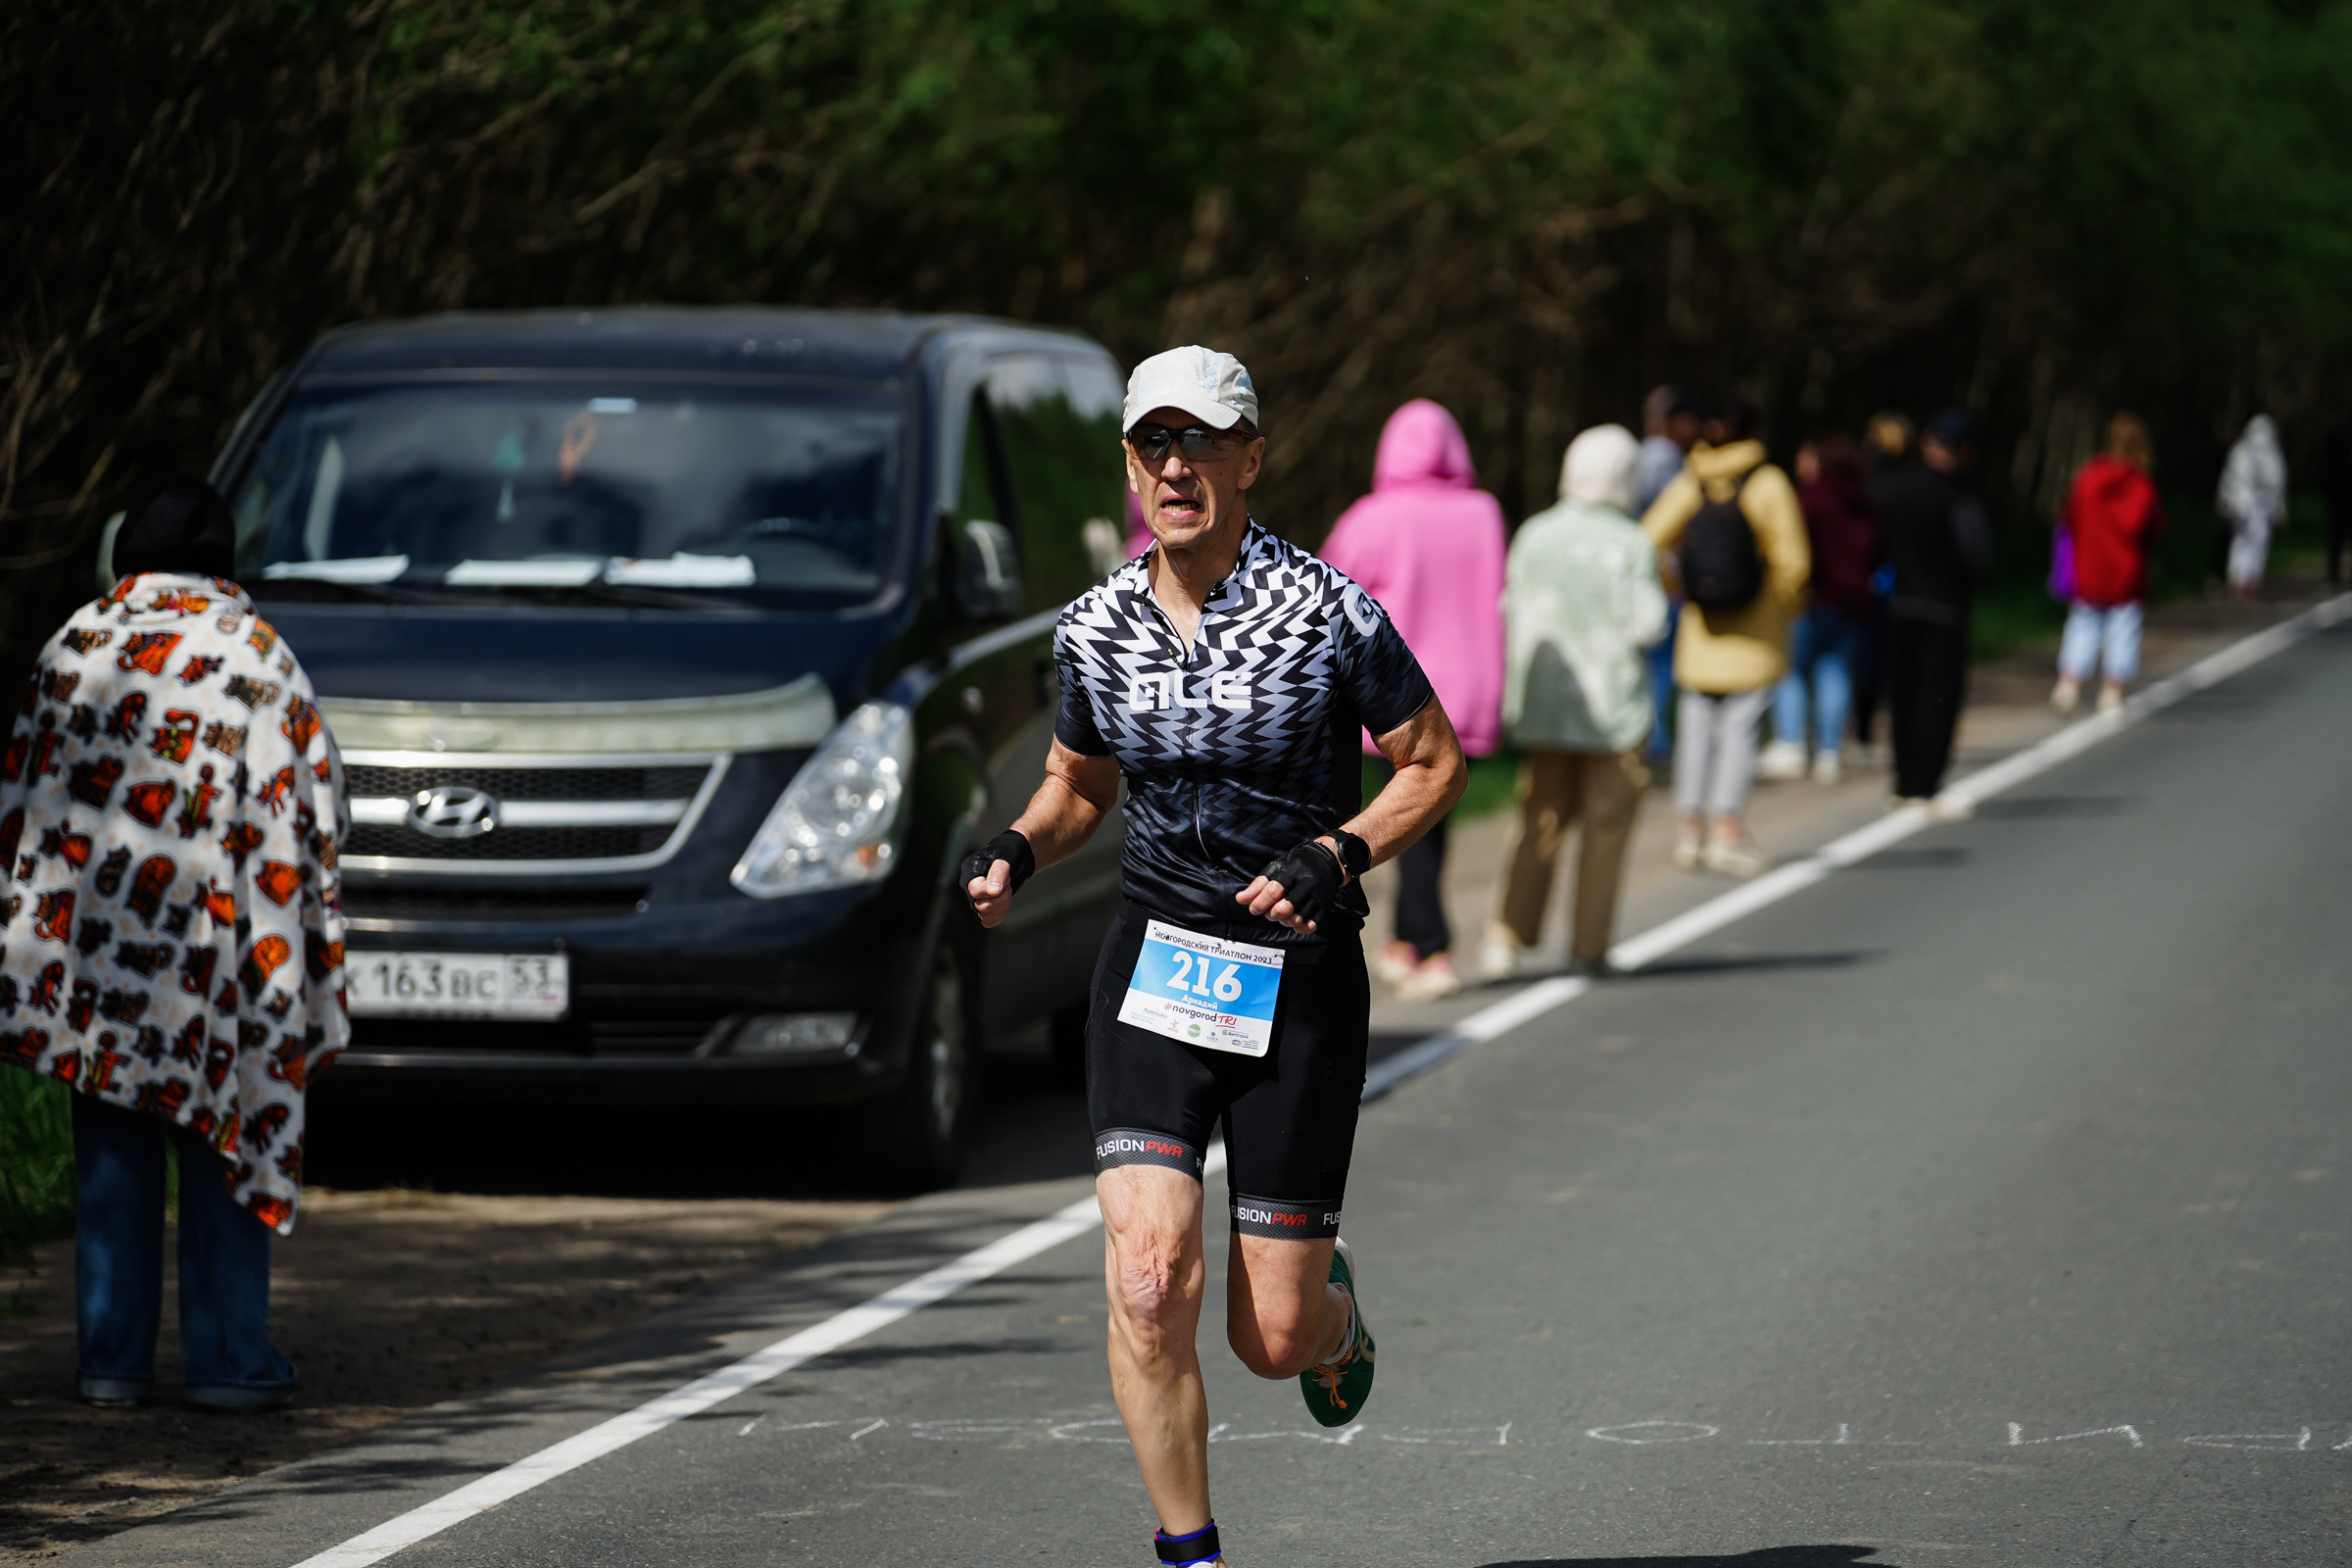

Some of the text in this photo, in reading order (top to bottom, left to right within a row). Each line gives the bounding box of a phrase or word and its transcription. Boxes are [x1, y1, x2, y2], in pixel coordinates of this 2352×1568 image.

[1154, 931, 1272, 964] НОВГОРОДСКИЙ ТРИАТЛОН 2023
[1166, 951, 1242, 1003] 216
[1181, 994, 1218, 1010] Аркадий
[737, 1415, 2352, 1451] РИТОРМОЗИ
